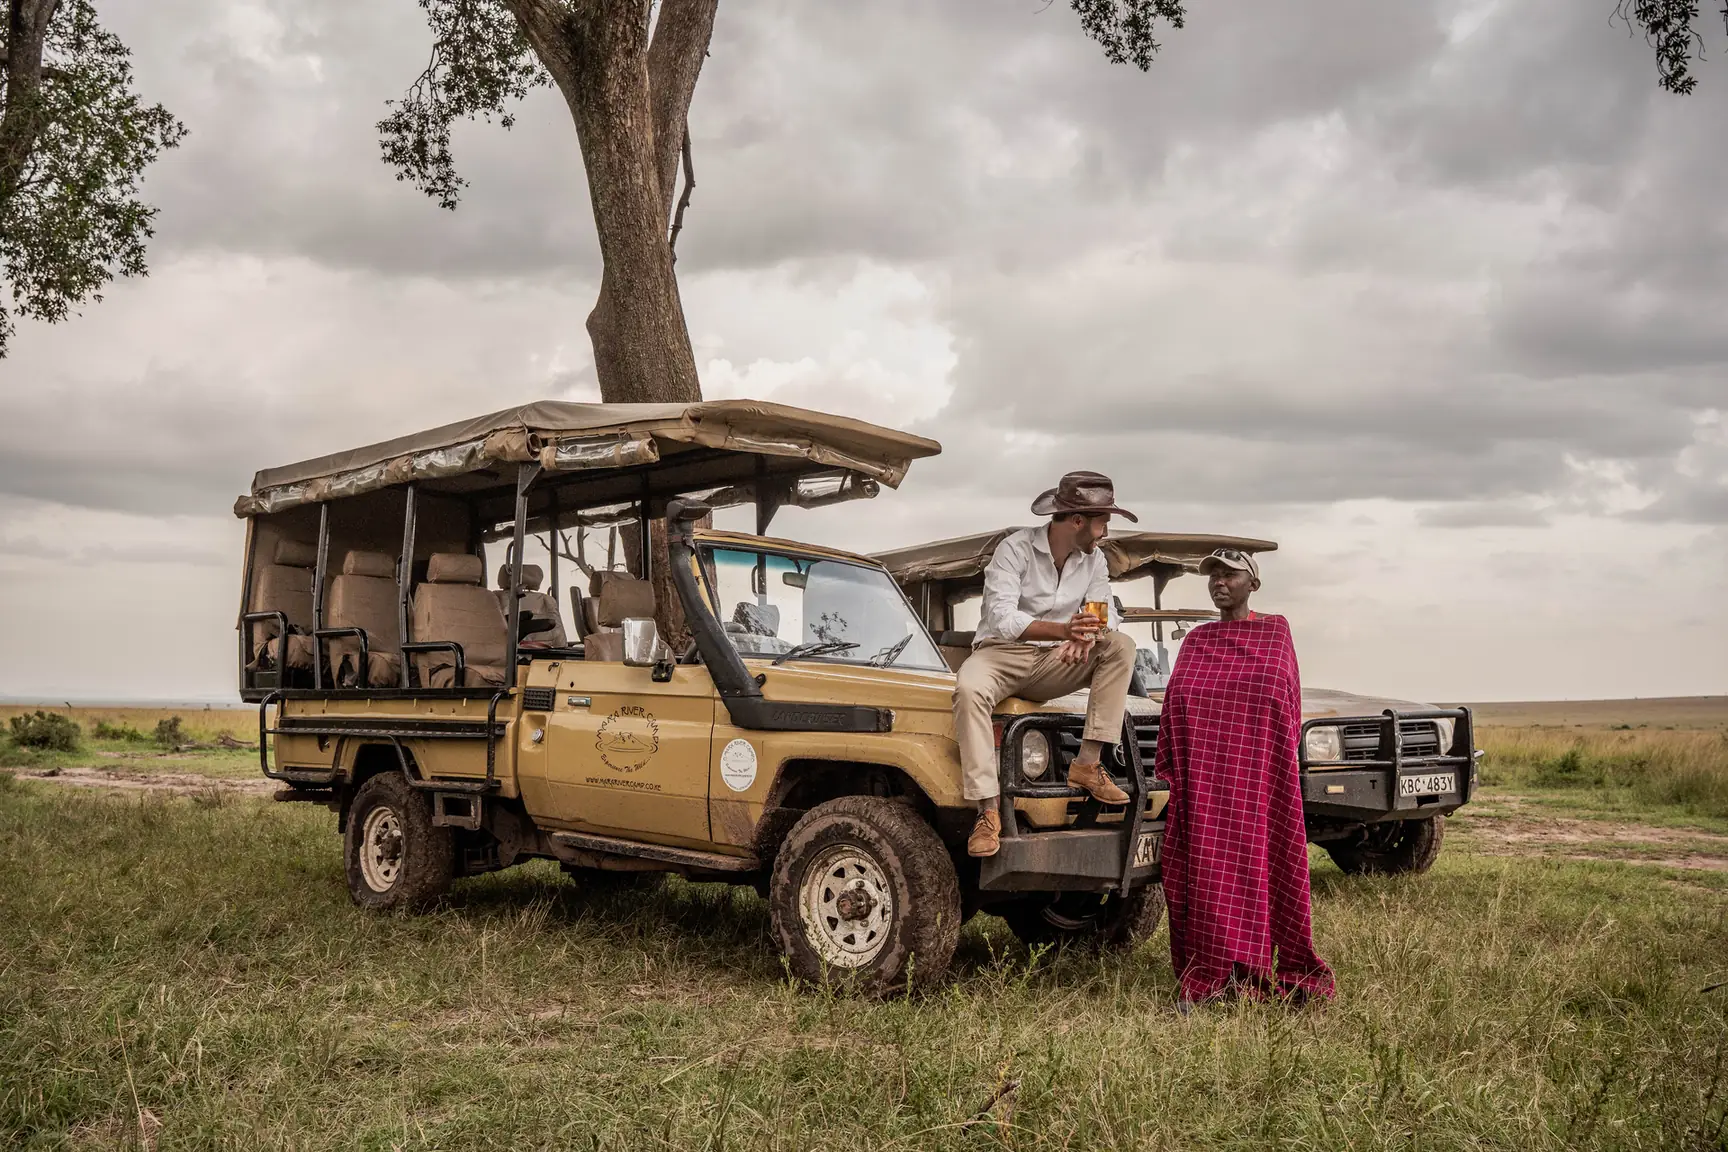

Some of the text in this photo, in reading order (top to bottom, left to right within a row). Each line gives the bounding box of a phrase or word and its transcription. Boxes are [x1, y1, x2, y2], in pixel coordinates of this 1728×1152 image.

[597, 706, 659, 744] MARA RIVER CAMP
[1401, 776, 1453, 794] KBC 483Y
